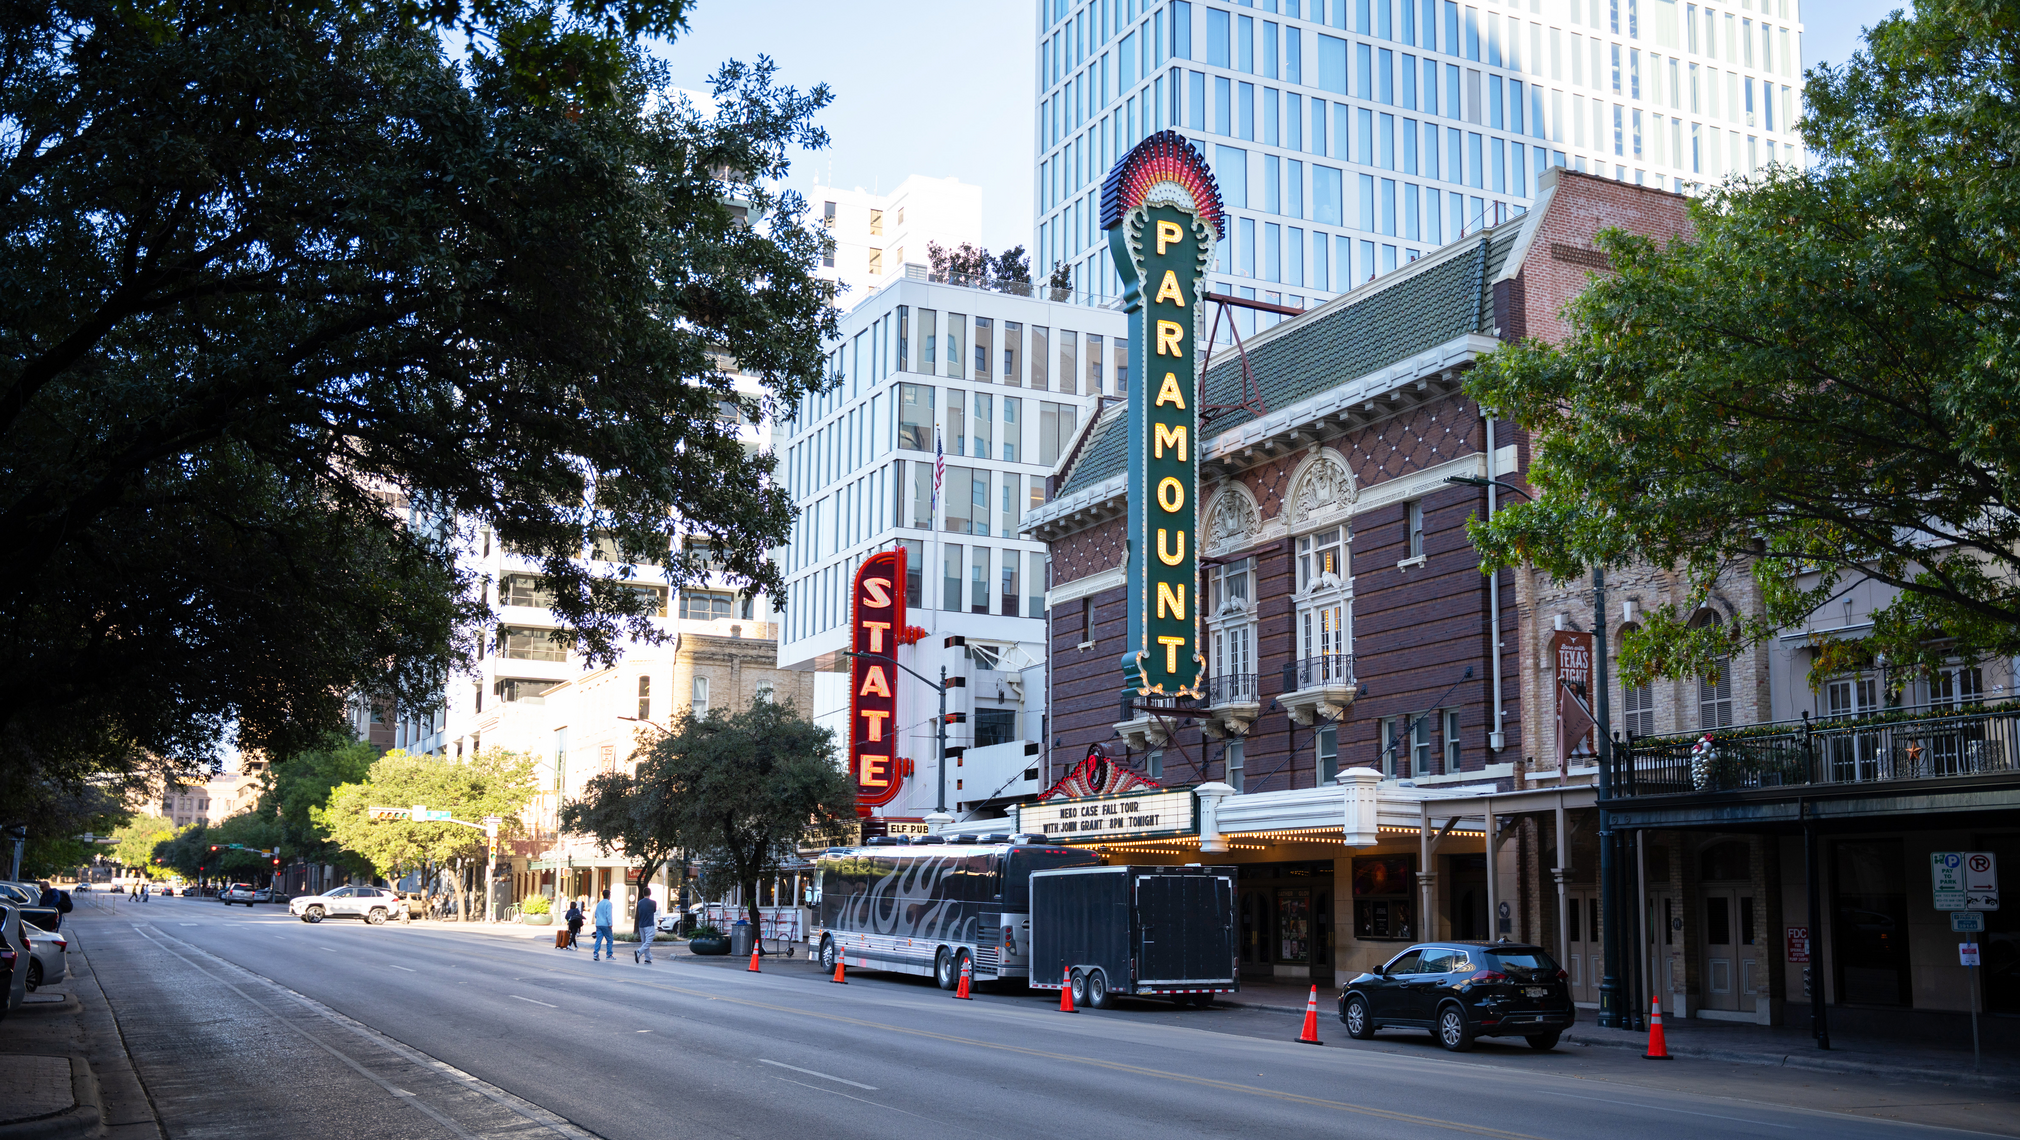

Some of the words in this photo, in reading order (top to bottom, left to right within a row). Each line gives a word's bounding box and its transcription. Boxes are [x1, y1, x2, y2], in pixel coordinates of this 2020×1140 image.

[1154, 219, 1188, 675] PARAMOUNT
[1558, 650, 1589, 669] TEXAS
[859, 577, 892, 787] STATE
[1560, 668, 1588, 686] FIGHT
[1060, 809, 1077, 819] NEKO
[1081, 805, 1098, 816] CASE
[1102, 804, 1118, 815] FALL
[1120, 801, 1139, 813] TOUR
[890, 824, 907, 834] ELF
[910, 824, 929, 834] PUB
[1043, 822, 1059, 834] WITH
[1060, 820, 1077, 833] JOHN
[1081, 819, 1104, 831] GRANT
[1109, 817, 1124, 829] 8PM
[1129, 814, 1160, 828] TONIGHT
[1788, 928, 1807, 939] FDC
